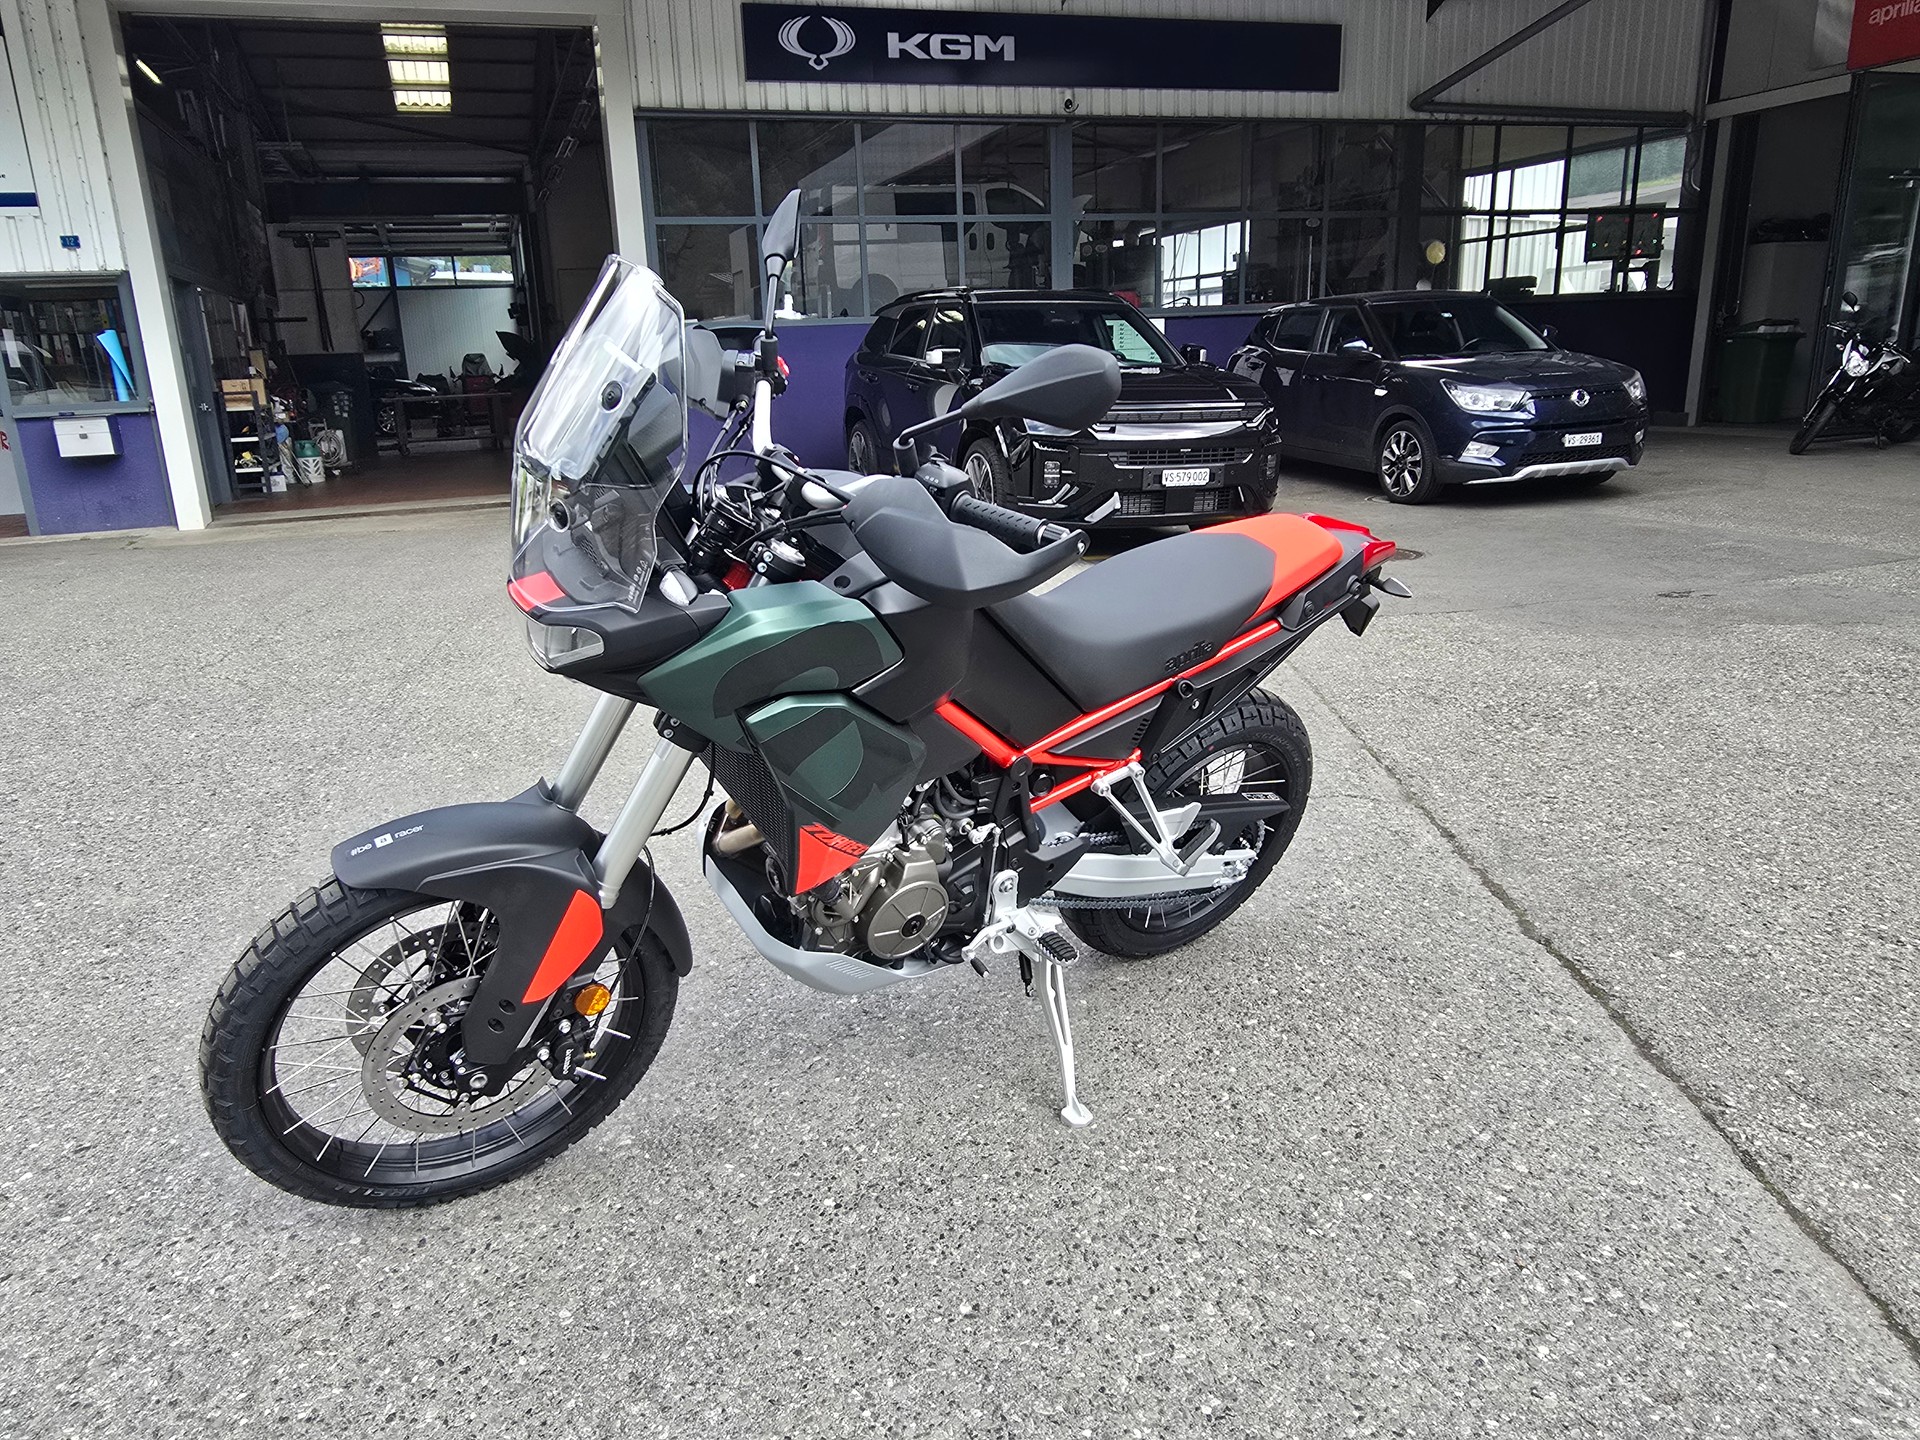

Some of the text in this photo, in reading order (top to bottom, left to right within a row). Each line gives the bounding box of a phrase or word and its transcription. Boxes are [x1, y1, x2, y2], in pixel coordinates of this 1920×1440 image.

[887, 32, 1016, 62] KGM
[65, 237, 75, 246] 12
[1163, 640, 1213, 673] aprilia
[394, 824, 424, 839] racer
